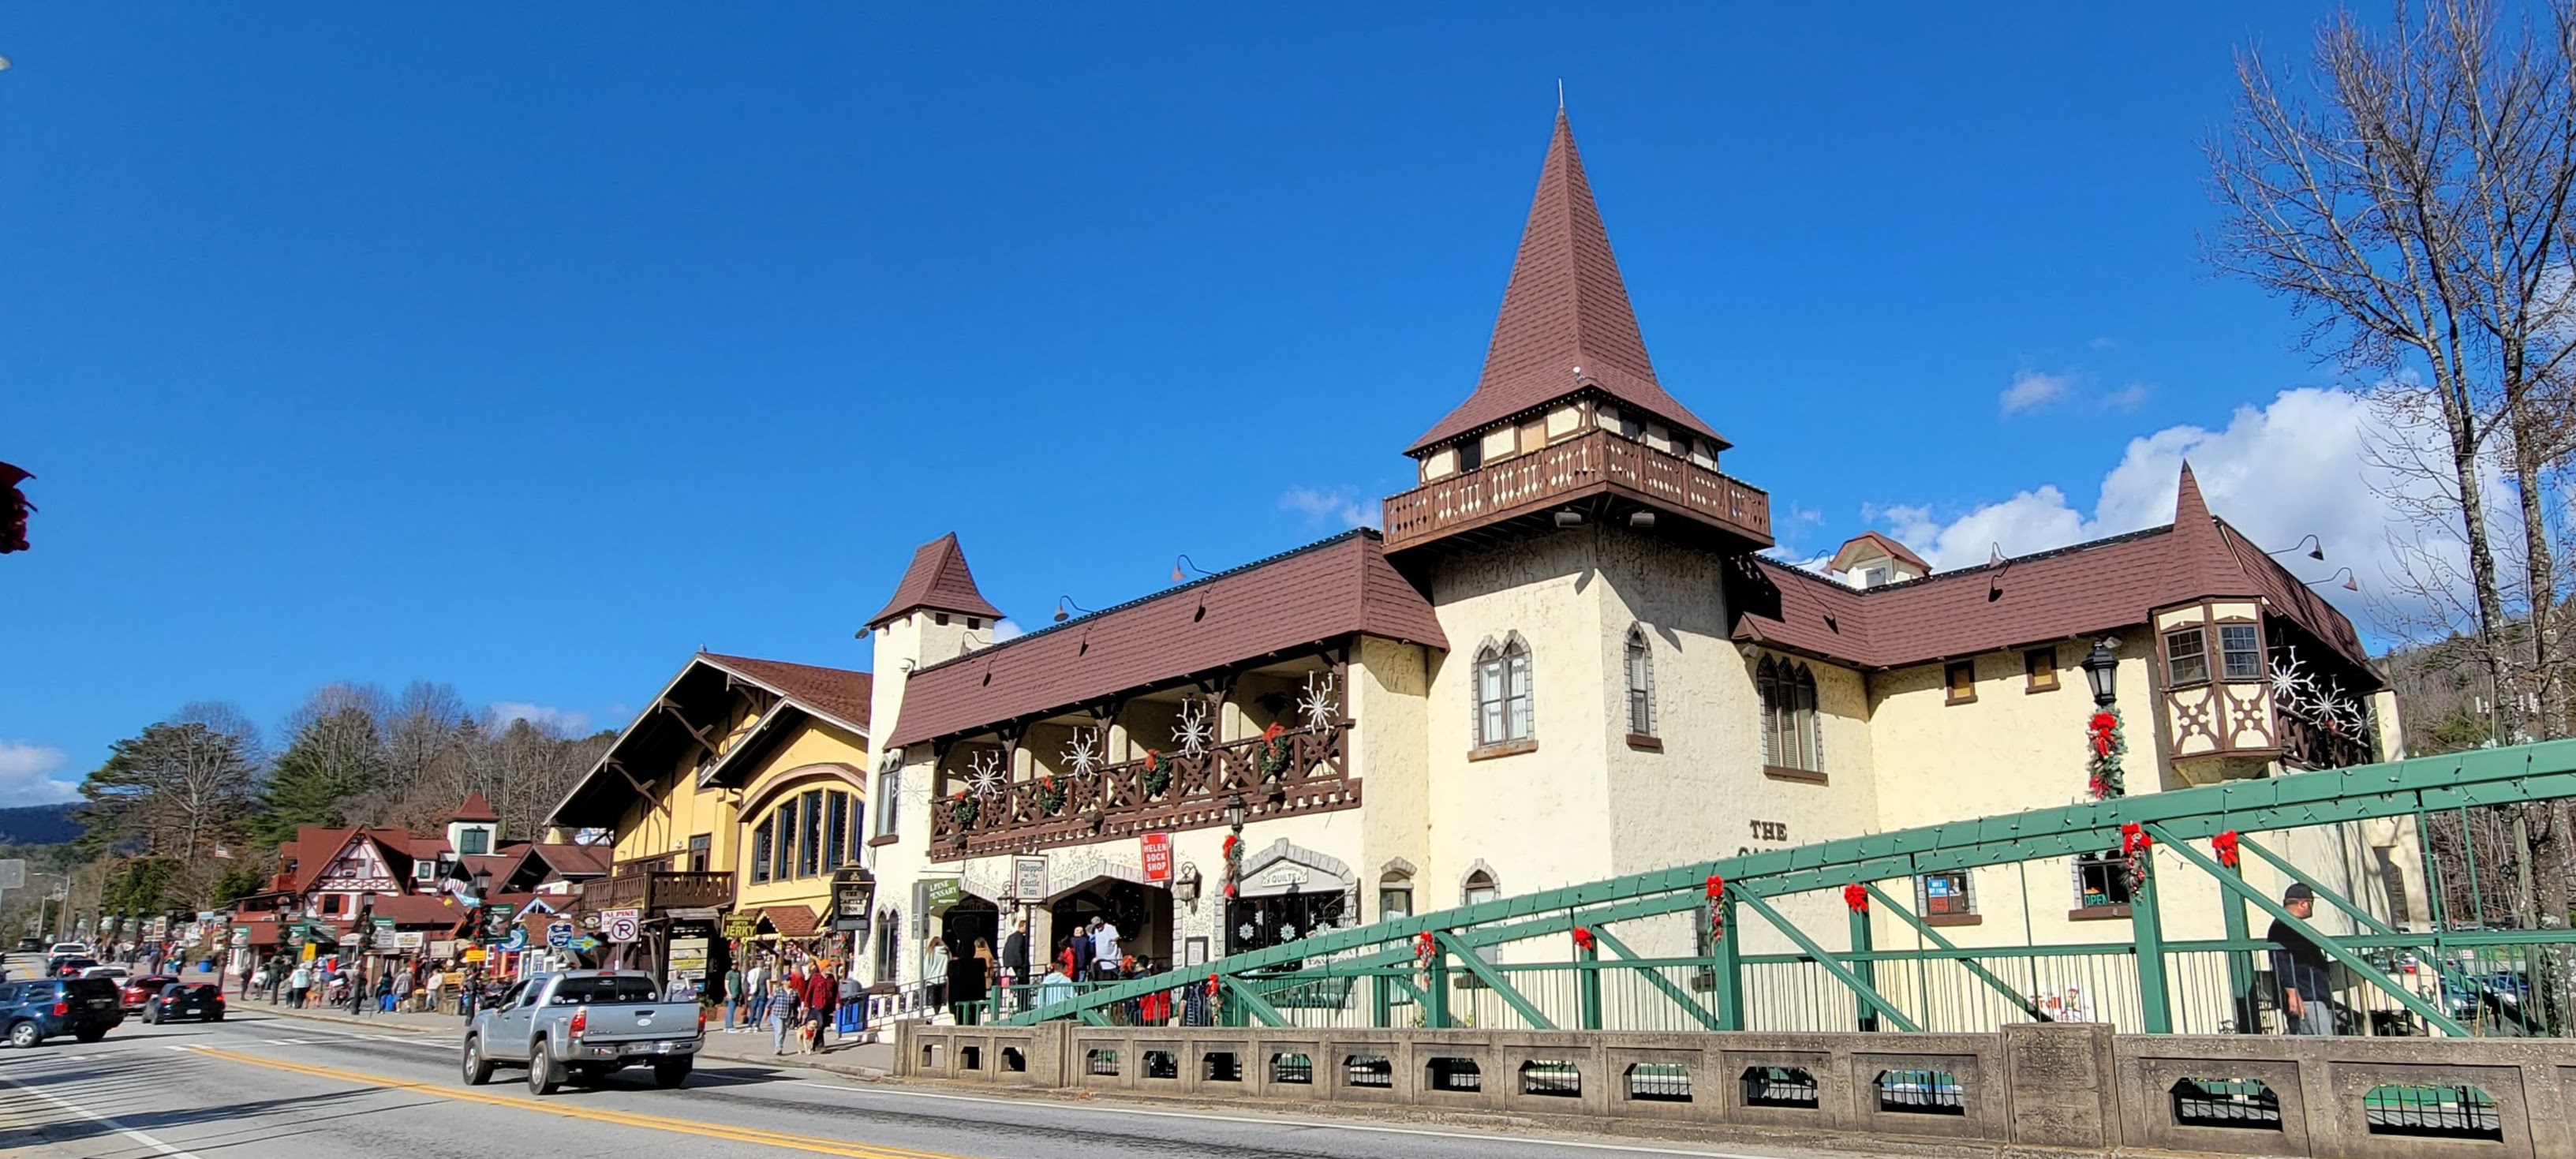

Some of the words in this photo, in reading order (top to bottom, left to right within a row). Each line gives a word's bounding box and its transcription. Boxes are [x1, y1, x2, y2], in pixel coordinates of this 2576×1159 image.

[1749, 819, 1788, 841] THE
[1144, 843, 1166, 852] HELEN
[1146, 853, 1165, 862] SOCK
[1147, 862, 1166, 871] SHOP
[1020, 878, 1040, 887] Castle
[1272, 873, 1296, 883] QUILTS
[2084, 894, 2108, 907] OPEN
[723, 925, 756, 937] JERKY
